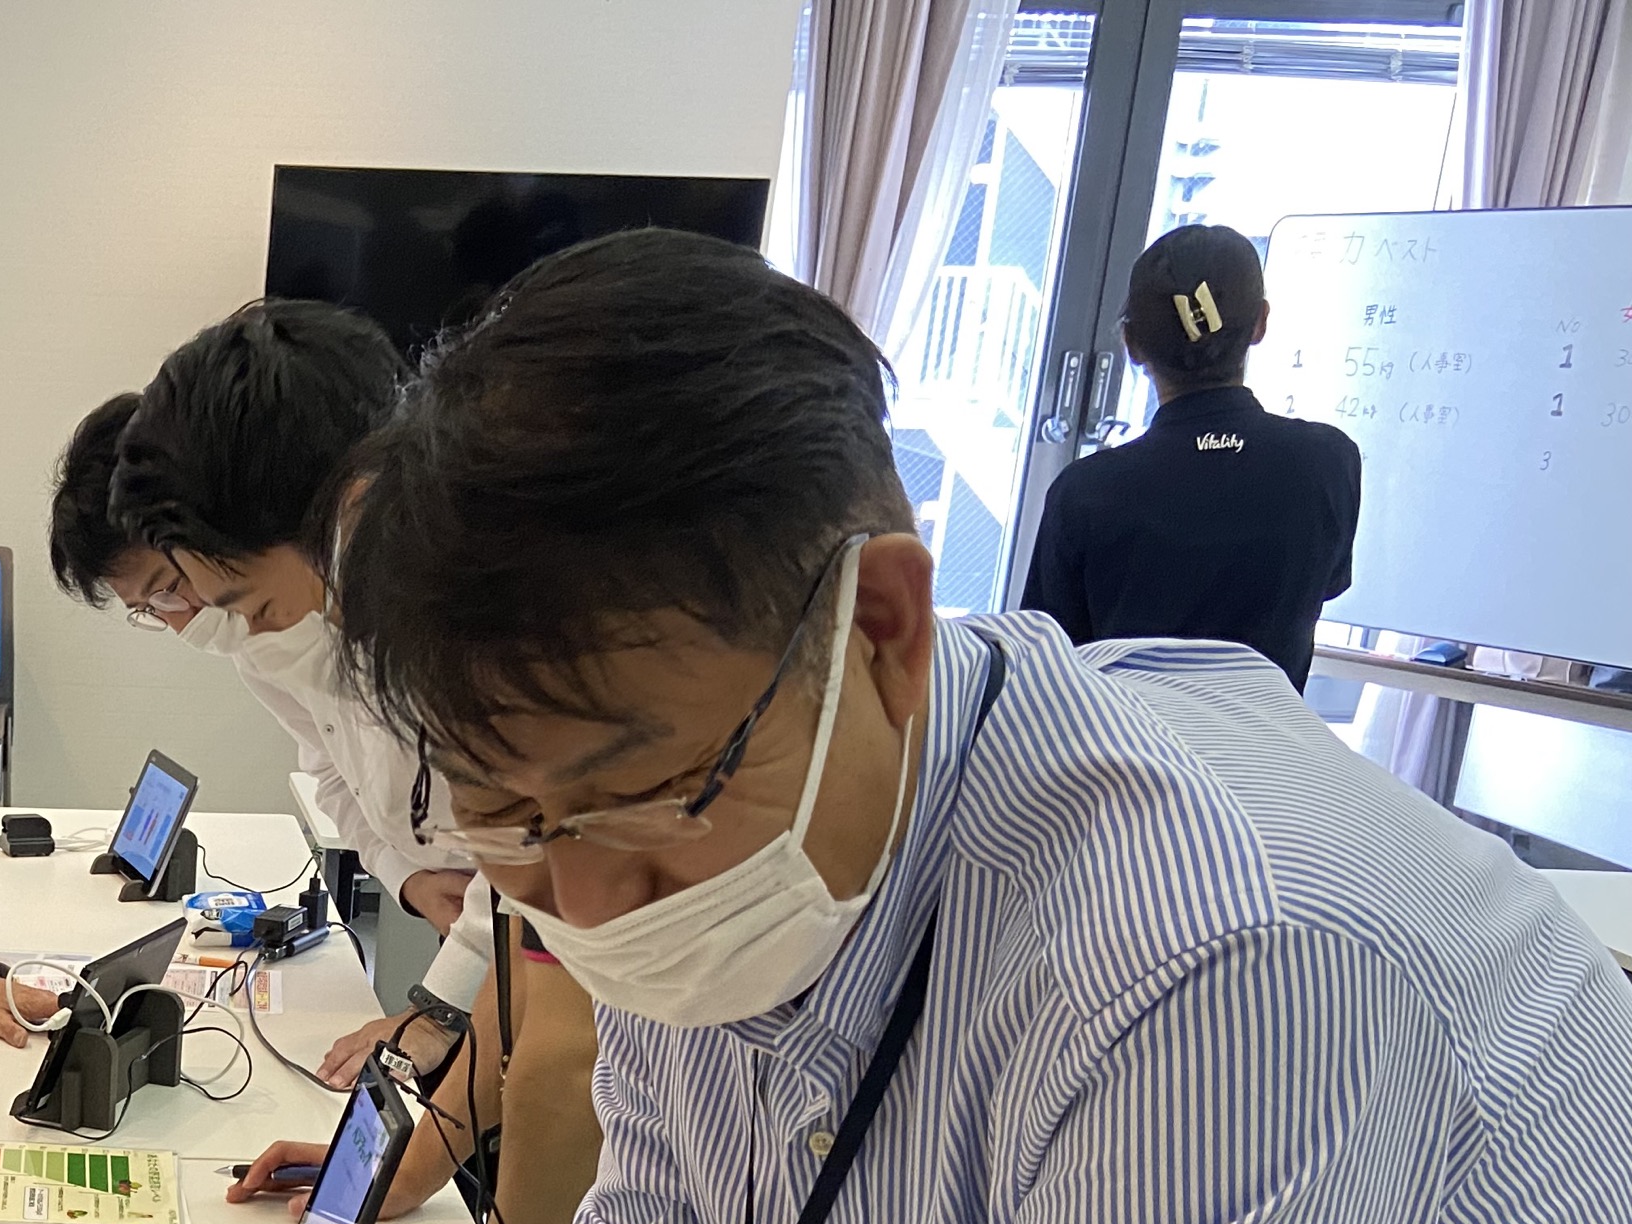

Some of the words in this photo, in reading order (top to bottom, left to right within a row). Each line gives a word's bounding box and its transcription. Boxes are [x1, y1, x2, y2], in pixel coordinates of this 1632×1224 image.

[1296, 231, 1436, 264] 力ベスト
[1364, 304, 1397, 325] 男性
[1292, 350, 1303, 368] 1
[1559, 344, 1573, 369] 1
[1551, 393, 1563, 417] 1
[1197, 432, 1244, 453] Vitality
[1540, 452, 1551, 470] 3
